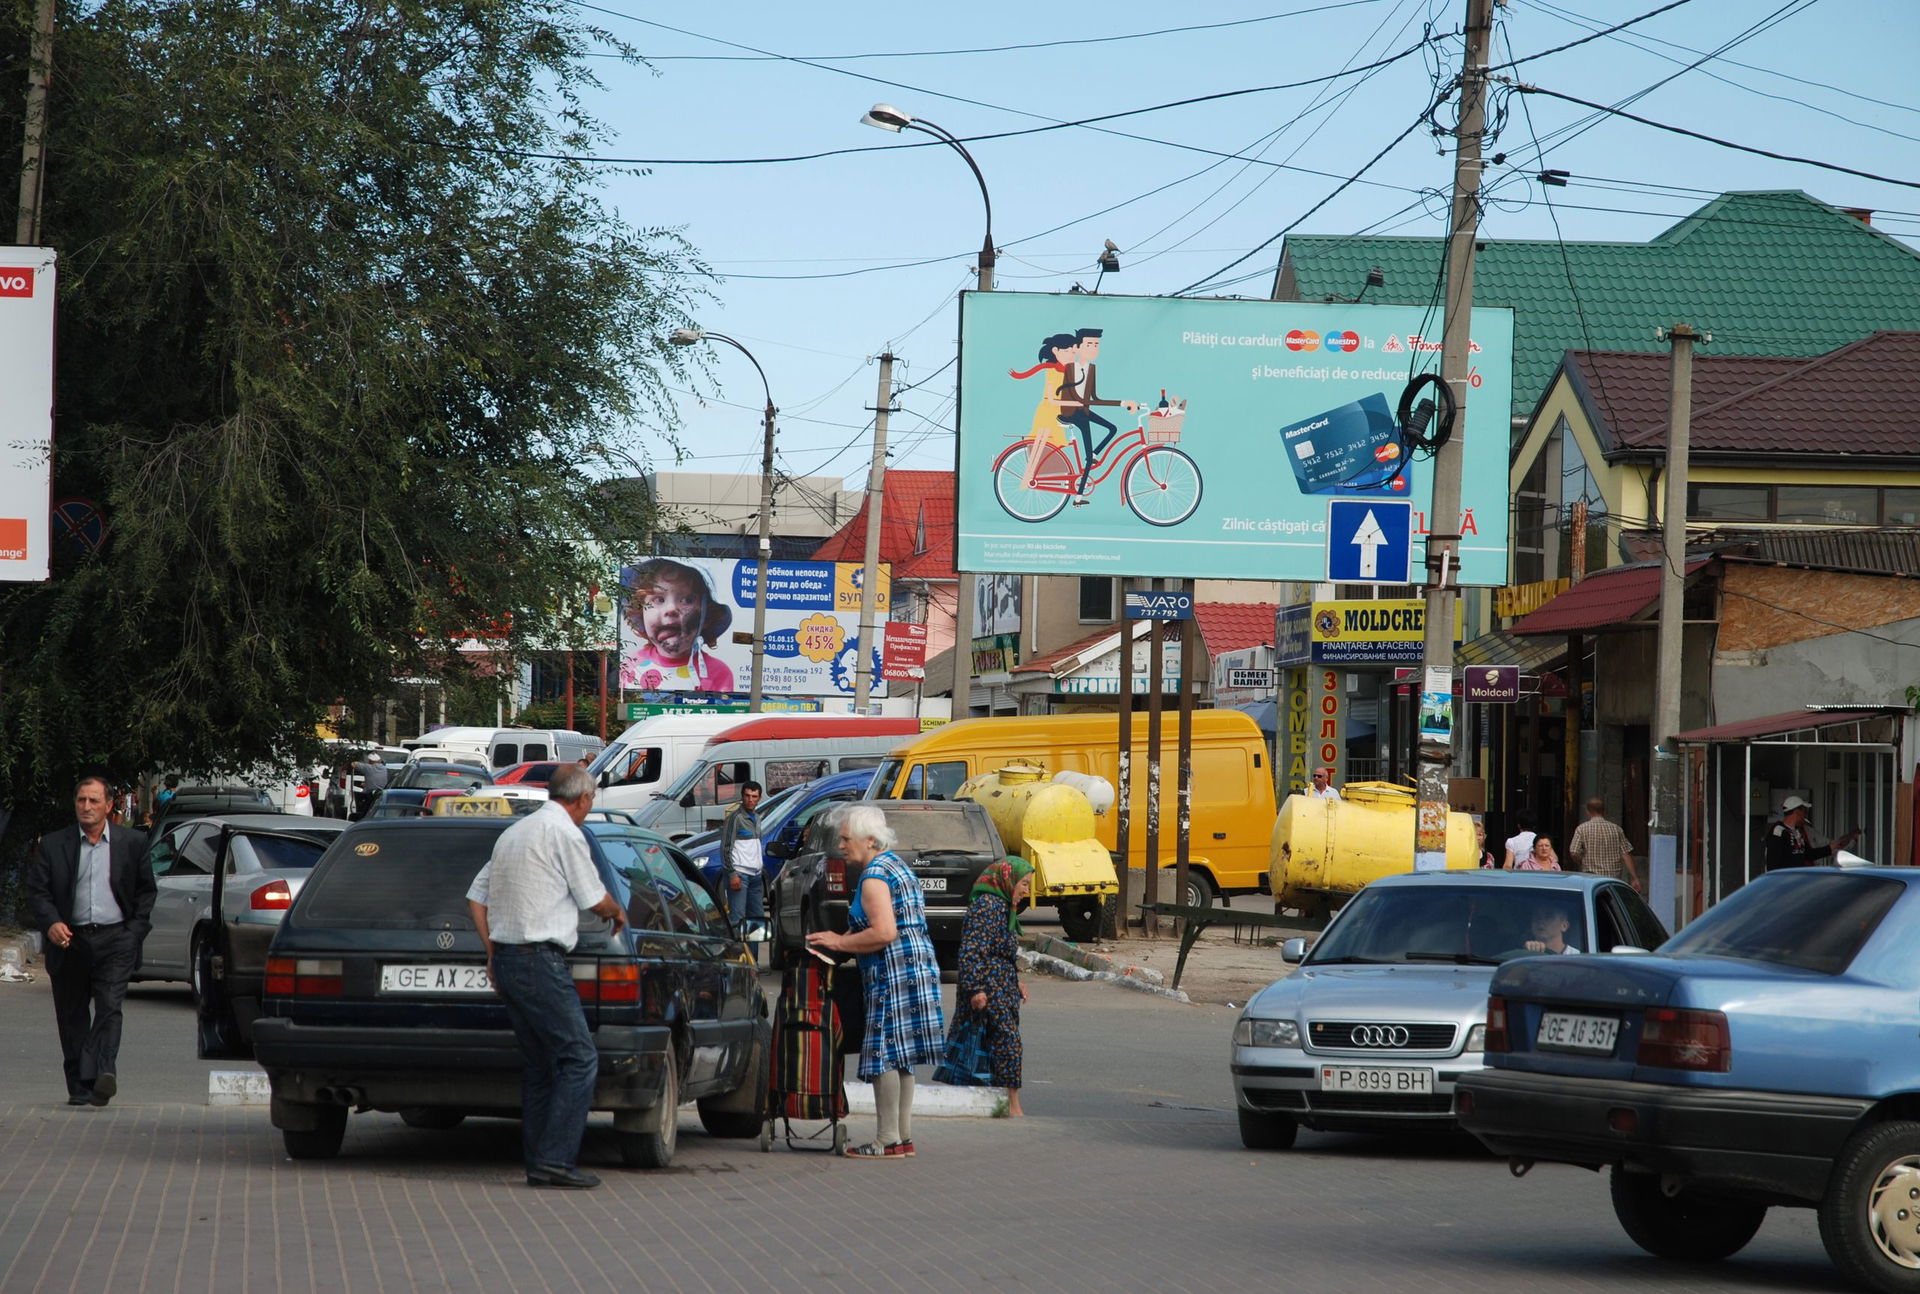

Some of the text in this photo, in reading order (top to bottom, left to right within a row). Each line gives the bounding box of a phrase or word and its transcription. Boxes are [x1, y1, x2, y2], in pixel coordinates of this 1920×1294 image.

[1221, 336, 1236, 345] cu
[1239, 335, 1282, 346] carduri
[1364, 336, 1375, 349] la
[1332, 367, 1348, 380] de
[1350, 371, 1360, 380] o
[1285, 418, 1329, 440] MasterCard
[1222, 517, 1256, 531] Zilnic
[795, 570, 828, 579] непоседа
[741, 577, 751, 587] Не
[771, 581, 788, 590] руки
[789, 582, 799, 590] до
[800, 580, 822, 589] обеда
[766, 592, 791, 601] срочно
[1344, 609, 1424, 631] MOLDCRE
[805, 635, 834, 650] 45%
[1376, 641, 1424, 650] AFACERILO
[1471, 687, 1514, 698] Moldcell
[800, 702, 817, 712] ПВХ
[453, 802, 498, 814] TAXI
[398, 968, 429, 988] GE
[435, 968, 458, 988] AX
[464, 968, 489, 989] 23
[1547, 1017, 1568, 1043] GE
[1587, 1021, 1613, 1047] 351
[1340, 1071, 1425, 1091] P 899 BH
